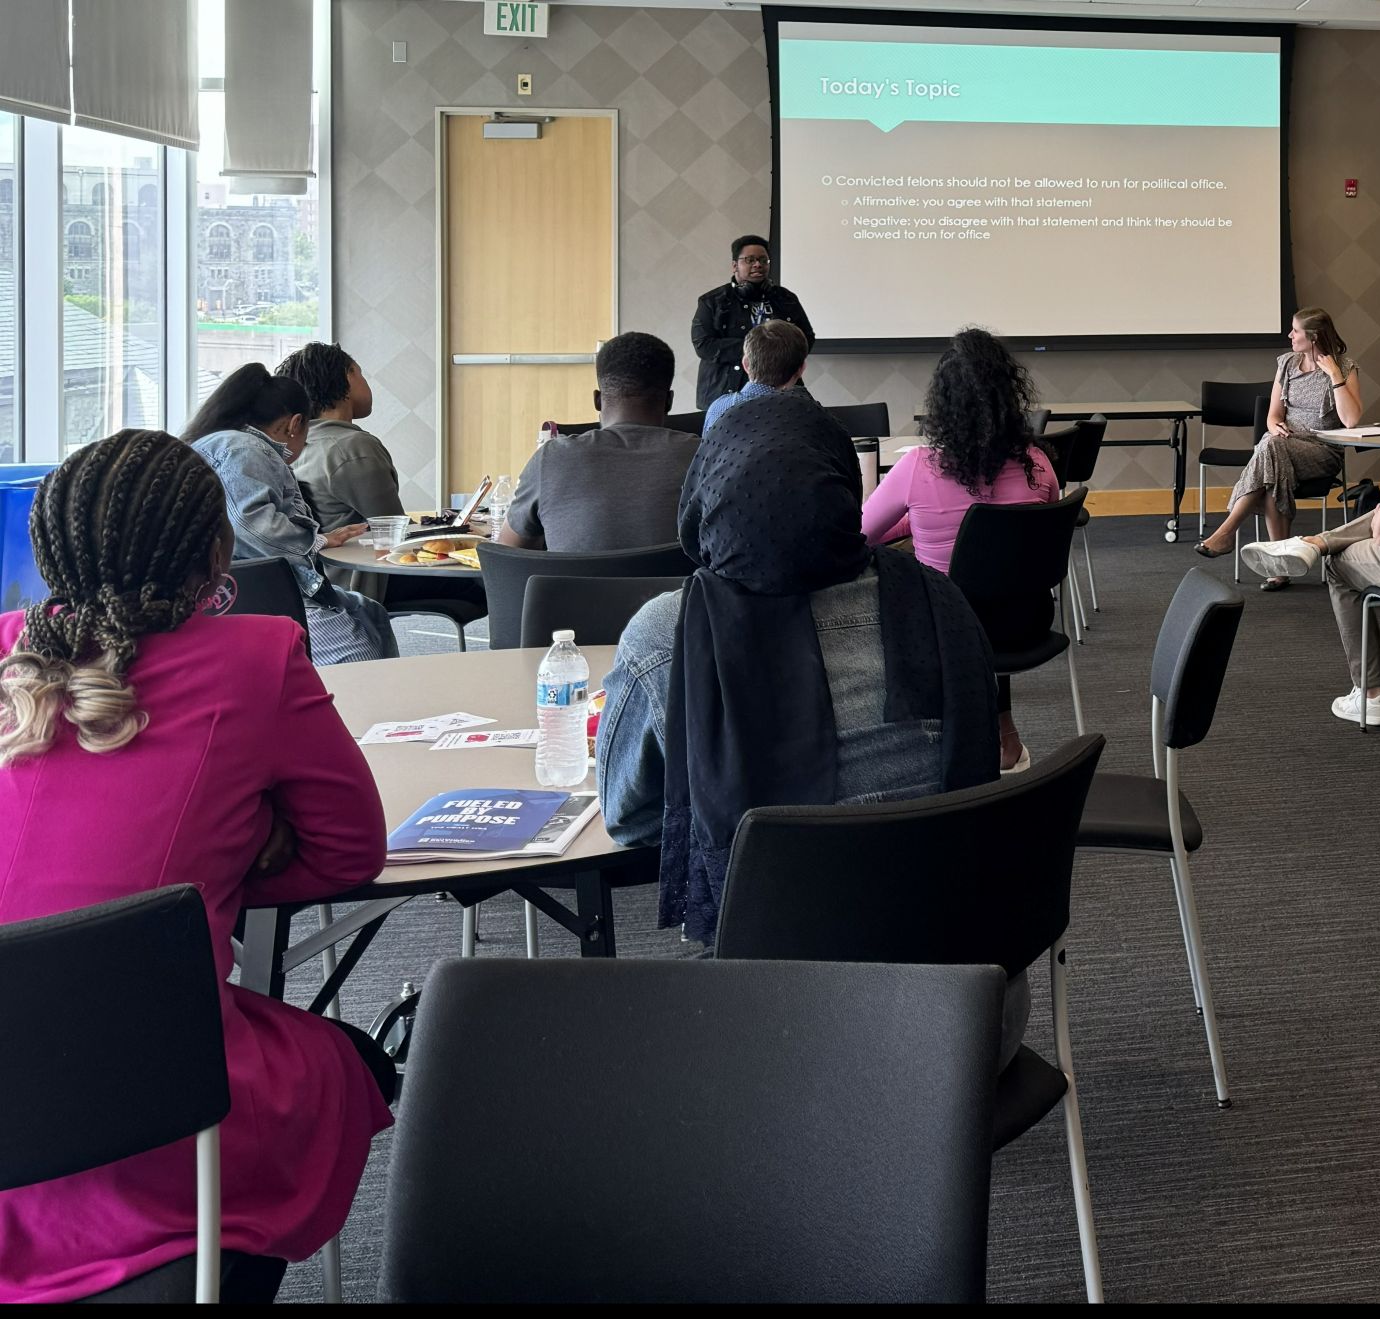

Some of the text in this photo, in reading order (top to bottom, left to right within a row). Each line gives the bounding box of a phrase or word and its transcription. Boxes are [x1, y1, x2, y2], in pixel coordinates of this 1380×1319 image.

[497, 2, 539, 32] EXIT
[820, 77, 961, 100] Today's Topic
[836, 175, 1227, 191] Convicted felons should not be allowed to run for political office.
[853, 196, 1092, 209] Affirmative: you agree with that statement
[853, 216, 1233, 228] Negative: you disagree with that statement and think they should be
[853, 229, 991, 240] allowed to run for office
[442, 799, 523, 810] FUELED
[459, 807, 493, 816] BY
[415, 814, 521, 825] PURPOSE
